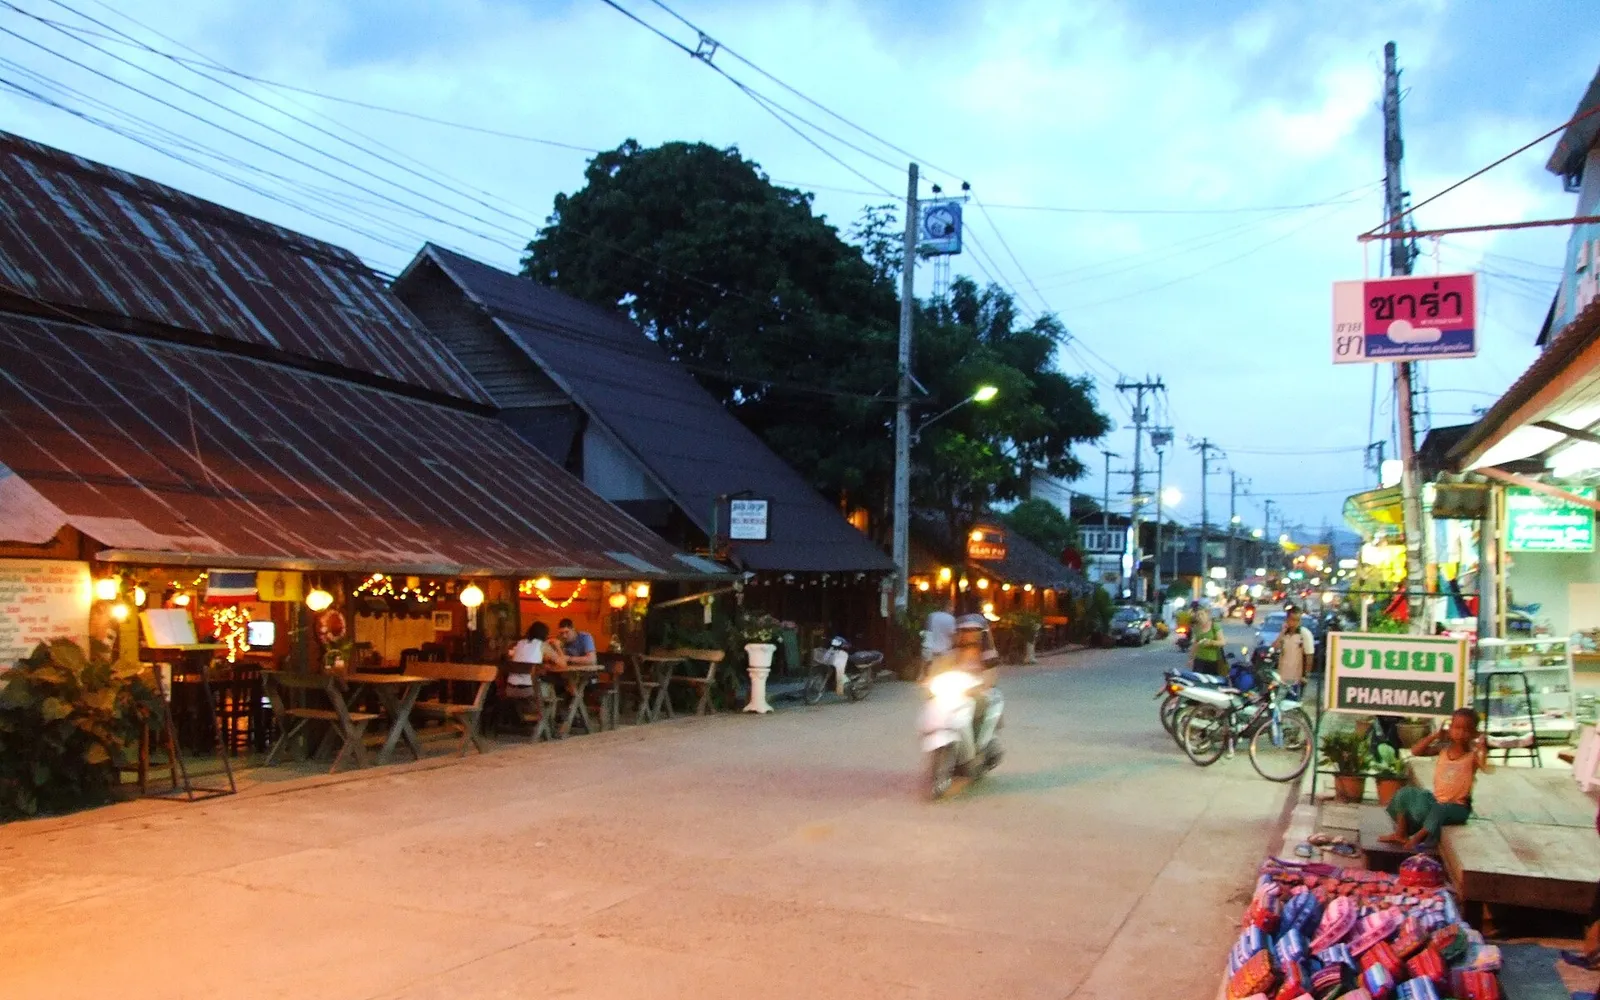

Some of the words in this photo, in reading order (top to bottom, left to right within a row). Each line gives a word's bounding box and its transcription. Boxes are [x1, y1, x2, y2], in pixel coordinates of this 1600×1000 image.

[1336, 335, 1363, 356] ยา
[1341, 648, 1454, 673] ขายยา
[1345, 687, 1445, 708] PHARMACY
